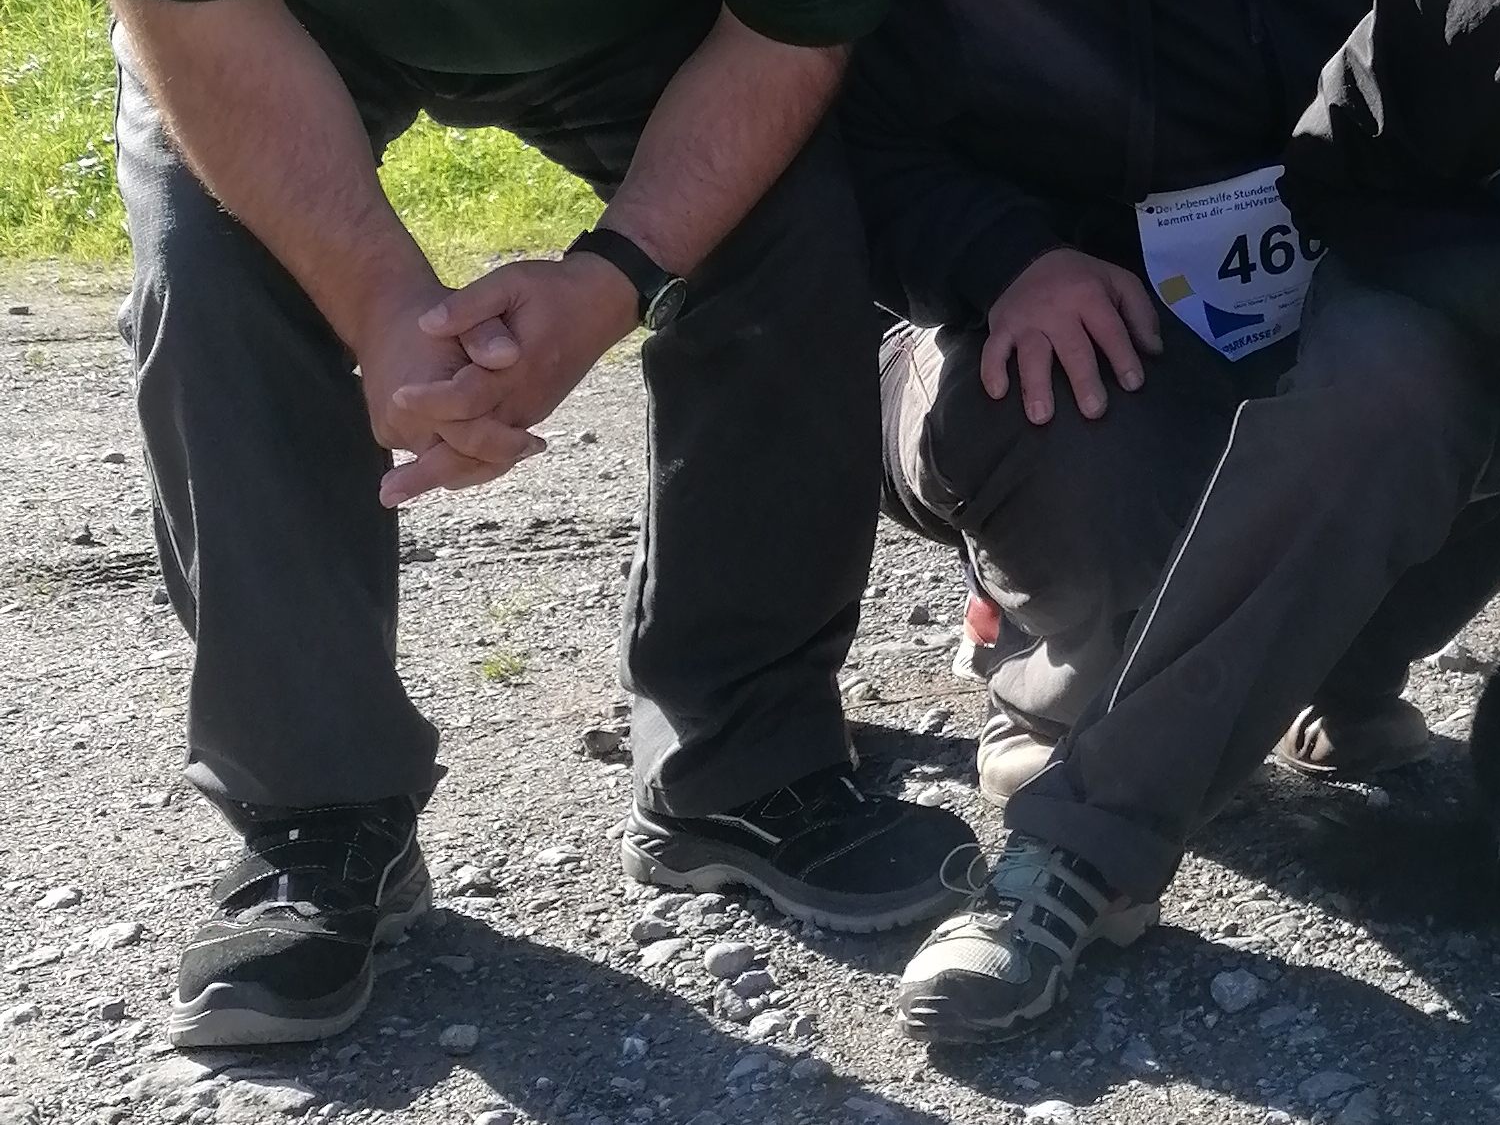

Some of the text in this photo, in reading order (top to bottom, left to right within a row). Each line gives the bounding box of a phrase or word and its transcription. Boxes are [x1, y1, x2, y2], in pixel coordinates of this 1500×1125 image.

[1155, 205, 1173, 215] Der
[1174, 193, 1232, 211] Lebenshilfe
[1157, 212, 1194, 227] kommt
[1196, 212, 1208, 220] zu
[1210, 206, 1224, 217] dir
